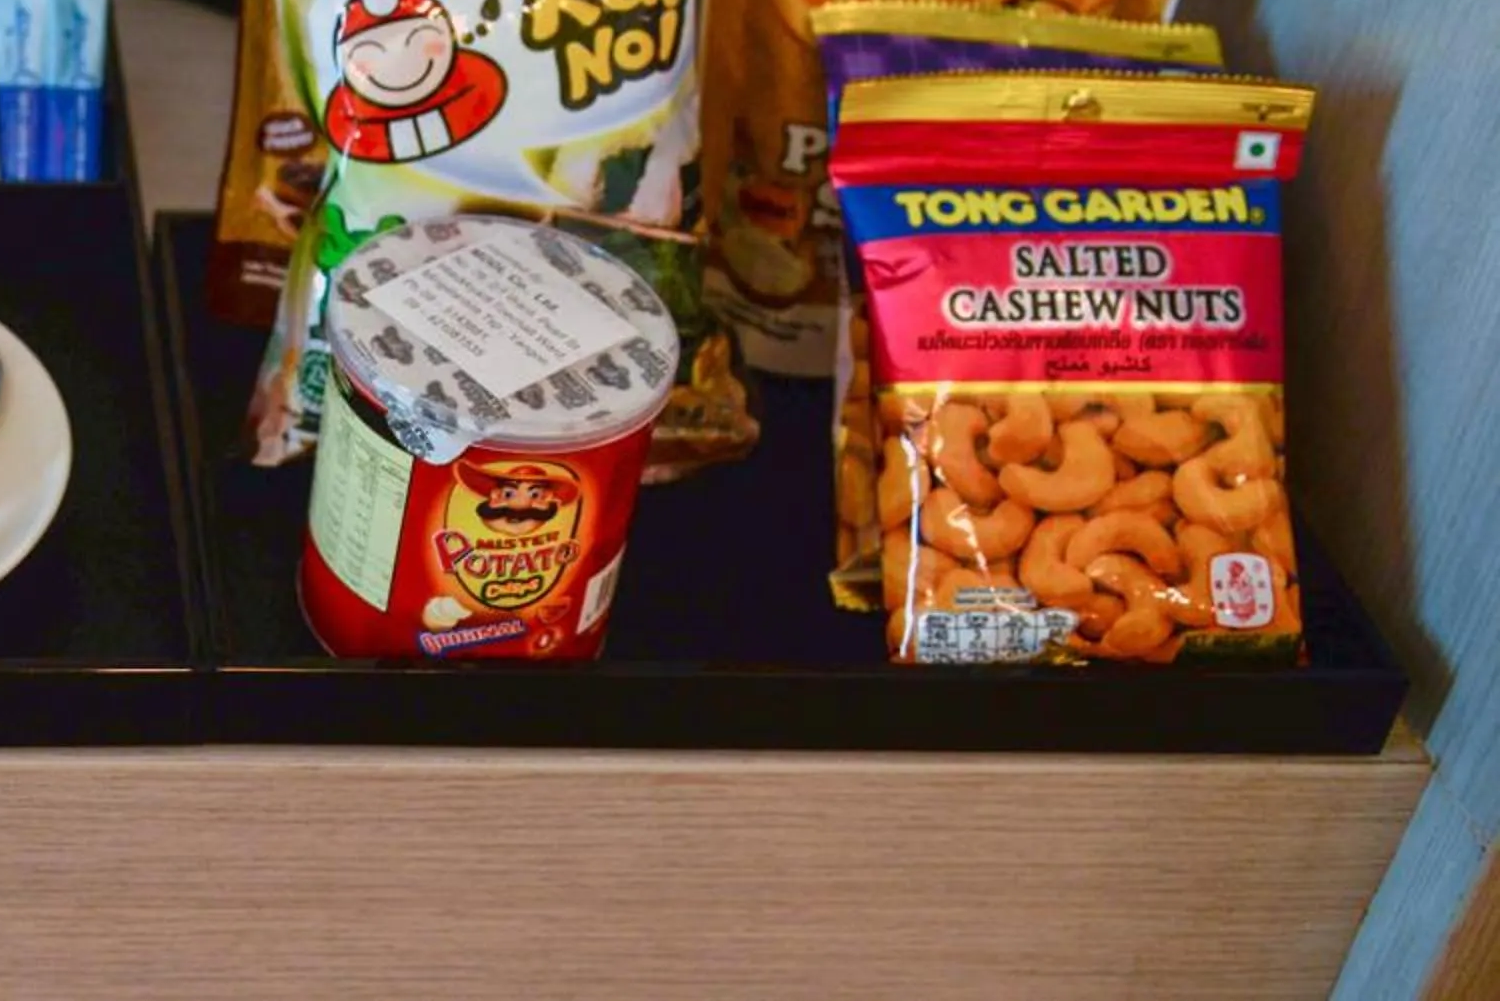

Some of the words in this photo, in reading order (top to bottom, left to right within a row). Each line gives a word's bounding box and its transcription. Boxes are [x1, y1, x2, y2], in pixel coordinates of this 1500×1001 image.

[896, 188, 1037, 227] TONG
[1043, 185, 1249, 224] GARDEN
[1014, 244, 1169, 278] SALTED
[948, 288, 1127, 323] CASHEW
[1134, 288, 1242, 323] NUTS
[432, 529, 581, 578] POTATO
[475, 530, 561, 551] MISTER
